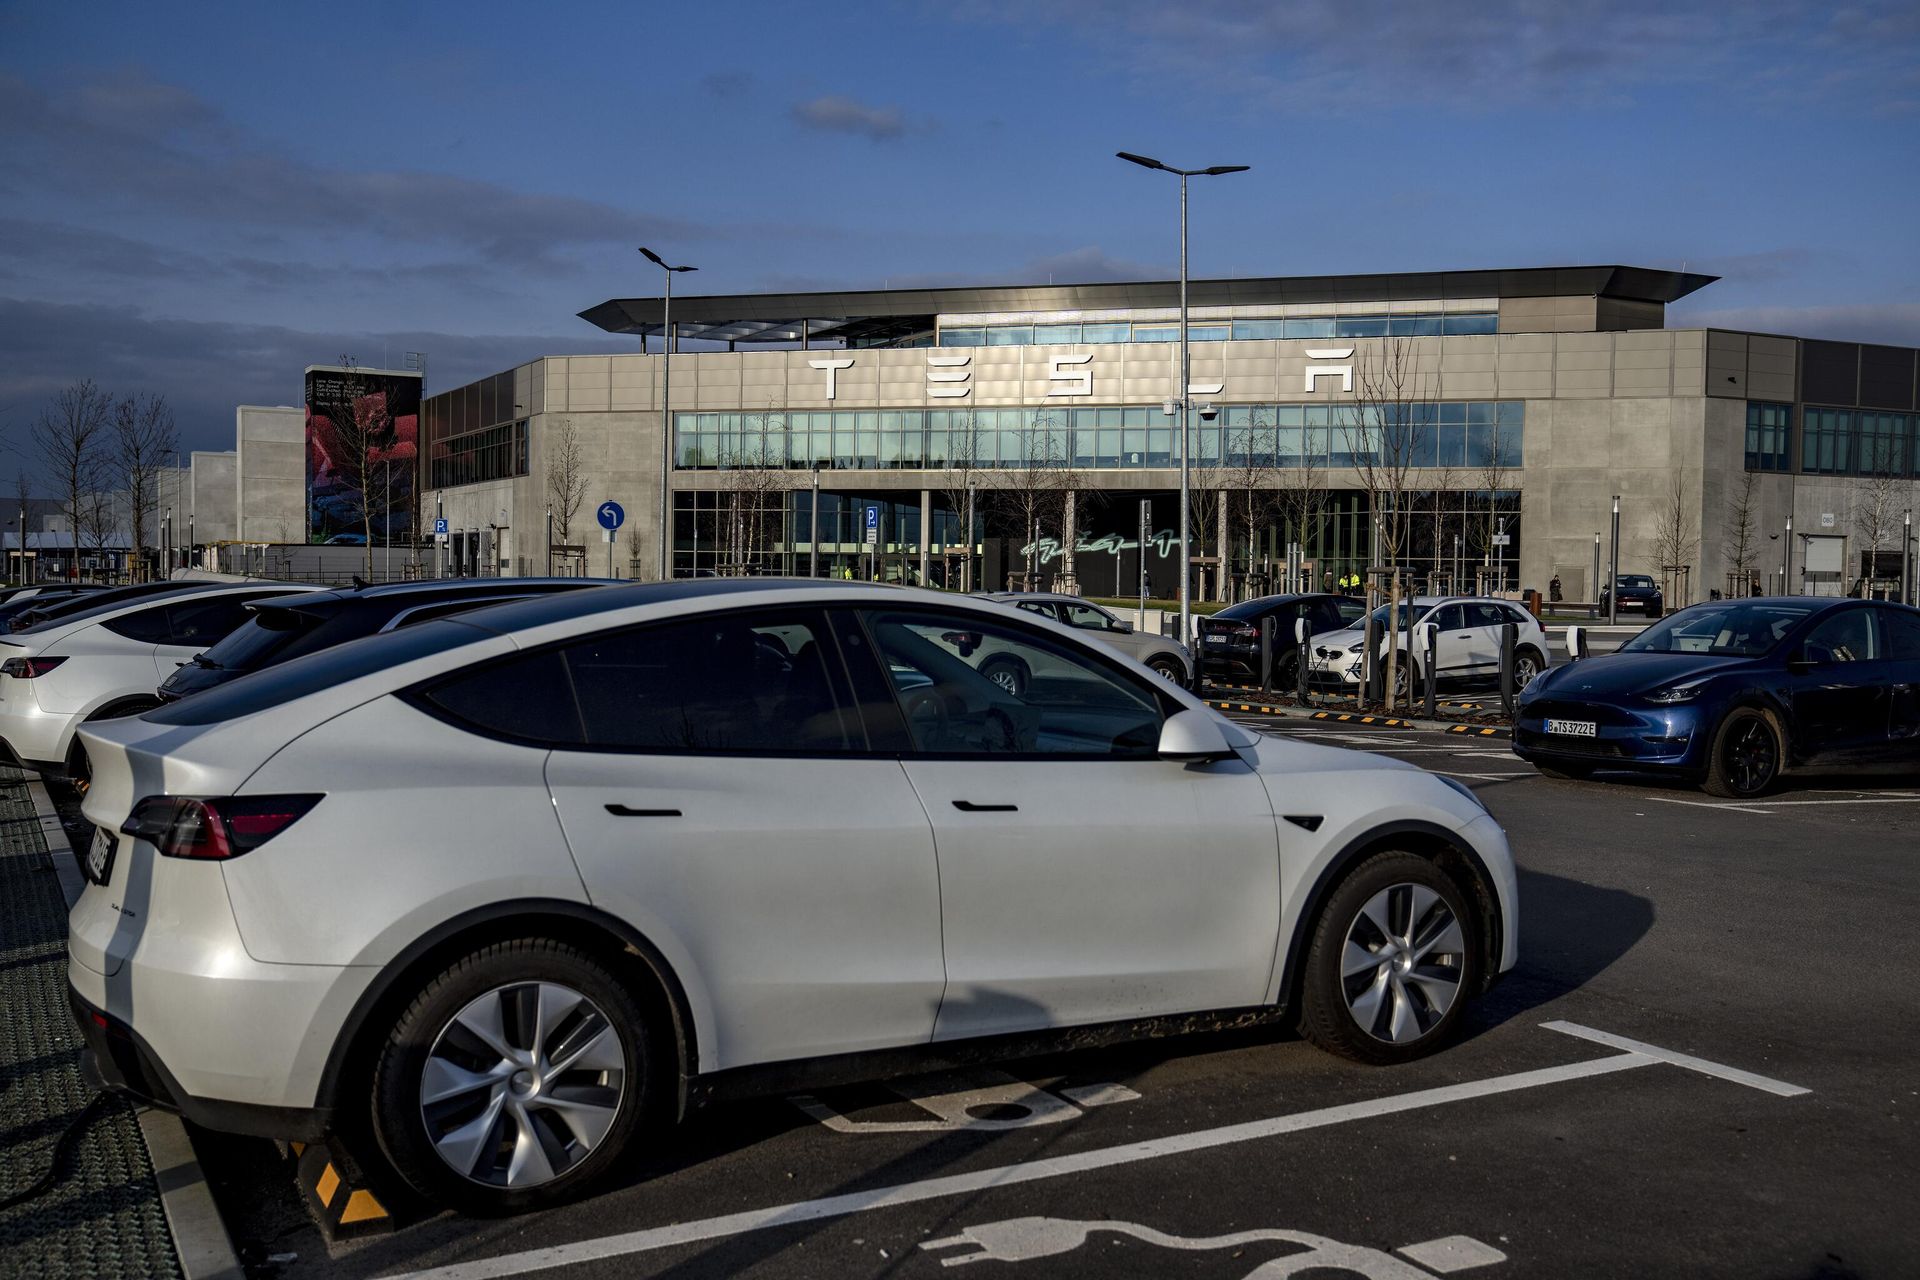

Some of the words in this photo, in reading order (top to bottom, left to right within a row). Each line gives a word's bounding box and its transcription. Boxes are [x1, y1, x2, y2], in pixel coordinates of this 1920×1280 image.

[808, 349, 1354, 400] TESLA
[437, 521, 445, 531] P
[868, 510, 875, 526] P
